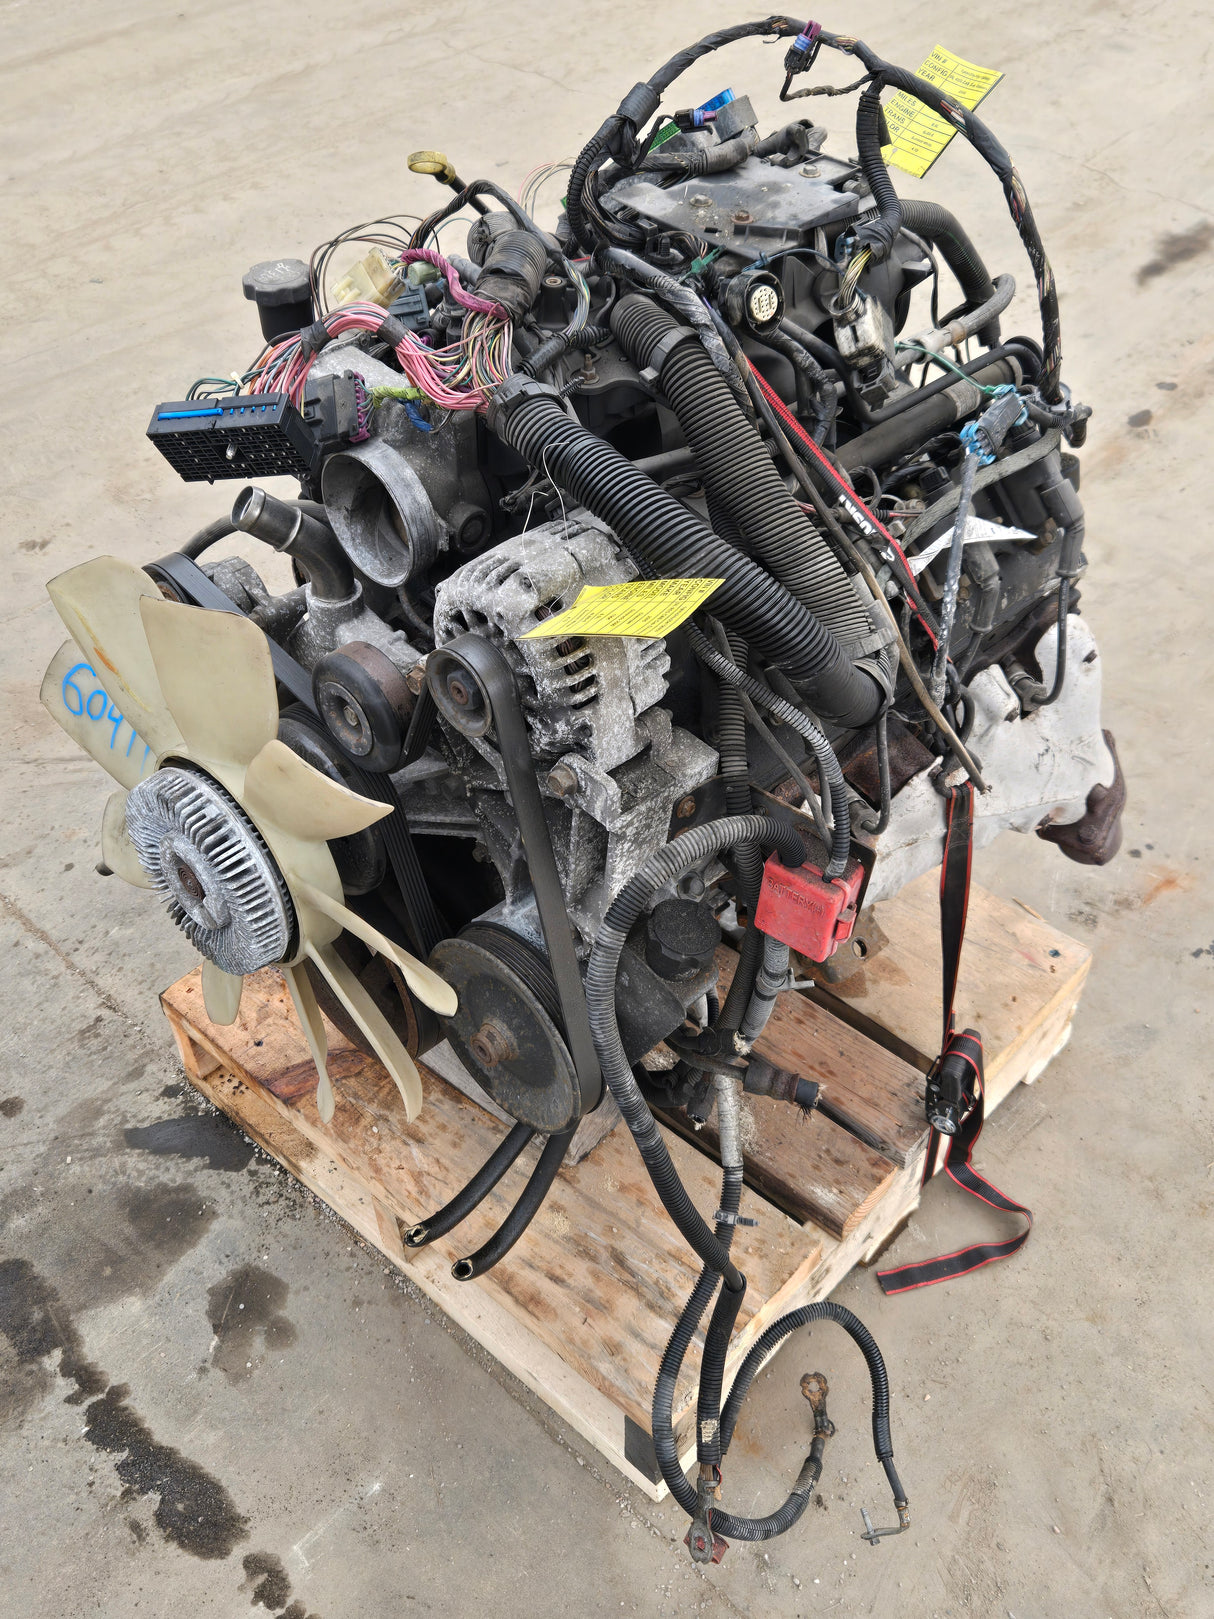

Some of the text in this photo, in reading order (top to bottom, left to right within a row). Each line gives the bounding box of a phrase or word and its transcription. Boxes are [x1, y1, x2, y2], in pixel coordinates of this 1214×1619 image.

[931, 51, 942, 62] VIN
[917, 68, 936, 82] YEAR
[924, 60, 949, 77] CONFIG
[897, 91, 917, 107] MILES
[884, 106, 906, 124] TRANS
[890, 98, 916, 118] ENGINE
[644, 580, 669, 600] MODEL
[660, 580, 680, 596] MAKE
